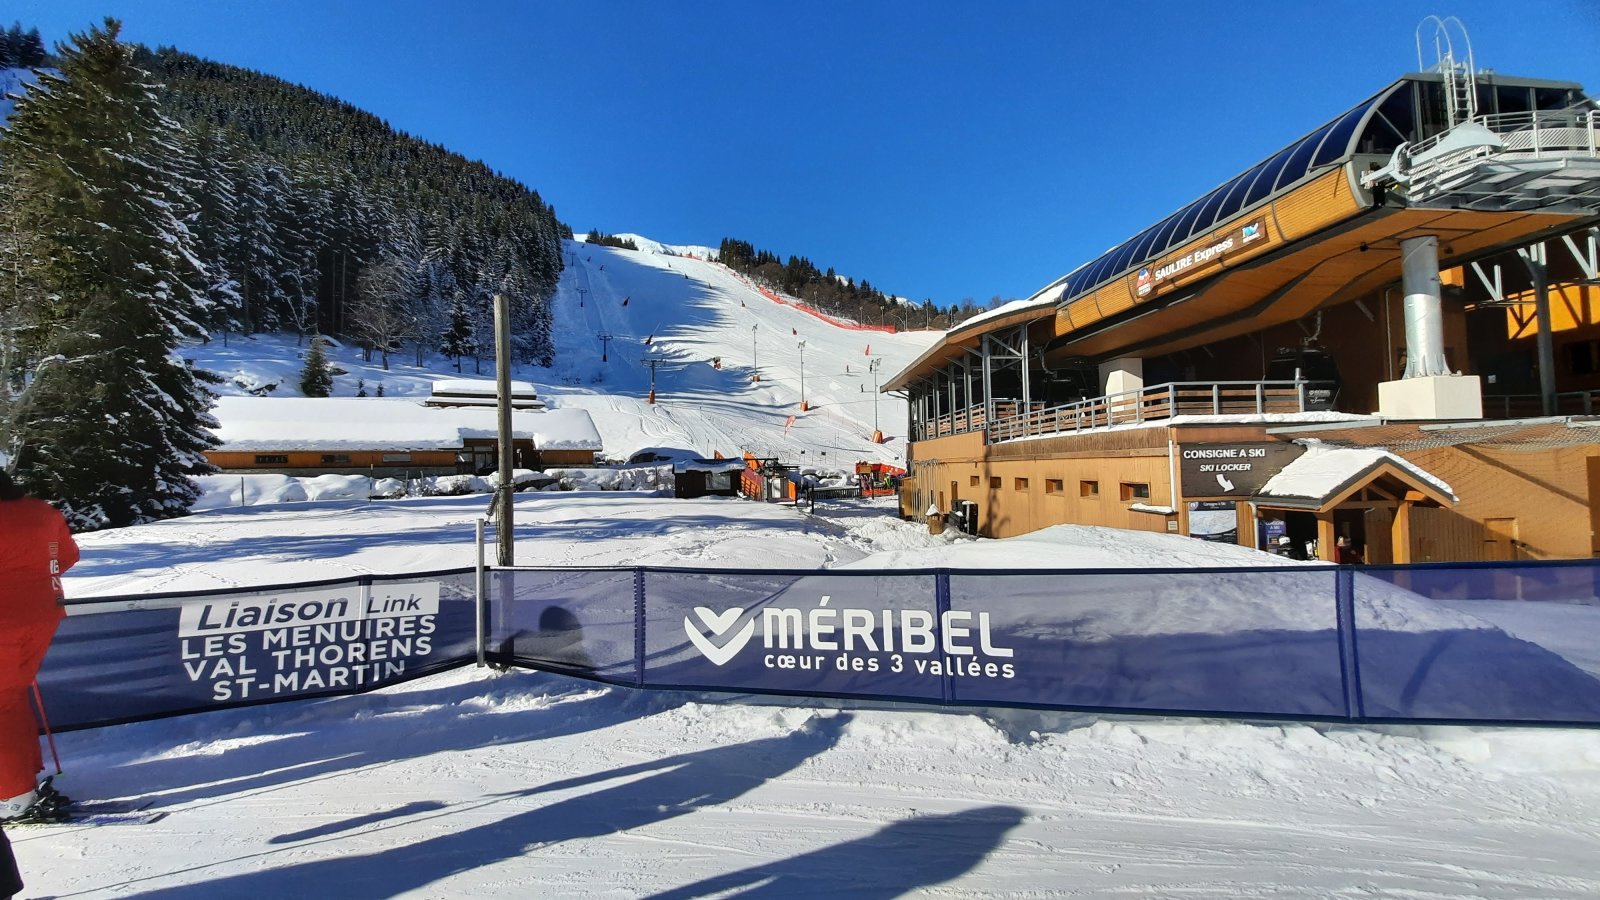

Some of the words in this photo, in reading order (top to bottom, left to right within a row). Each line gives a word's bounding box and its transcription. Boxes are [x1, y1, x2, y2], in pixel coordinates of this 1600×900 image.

[1155, 255, 1193, 281] SAULIRE
[1194, 238, 1234, 263] Express
[1183, 449, 1238, 459] CONSIGNE
[1239, 448, 1247, 458] A
[1248, 448, 1266, 457] SKI
[1200, 464, 1215, 472] SKI
[1215, 463, 1252, 472] LOCKER
[197, 597, 348, 631] Liaison
[367, 593, 422, 614] Link
[762, 595, 1014, 658] MÉRIBEL
[181, 633, 247, 660] LES
[262, 615, 436, 650] MENUIRES
[183, 655, 257, 681] VAL
[271, 636, 432, 671] THORENS
[212, 659, 405, 701] ST-MARTIN
[764, 654, 825, 670] cœur
[836, 652, 880, 672] des
[890, 655, 904, 673] 3
[914, 656, 1015, 679] vallées
